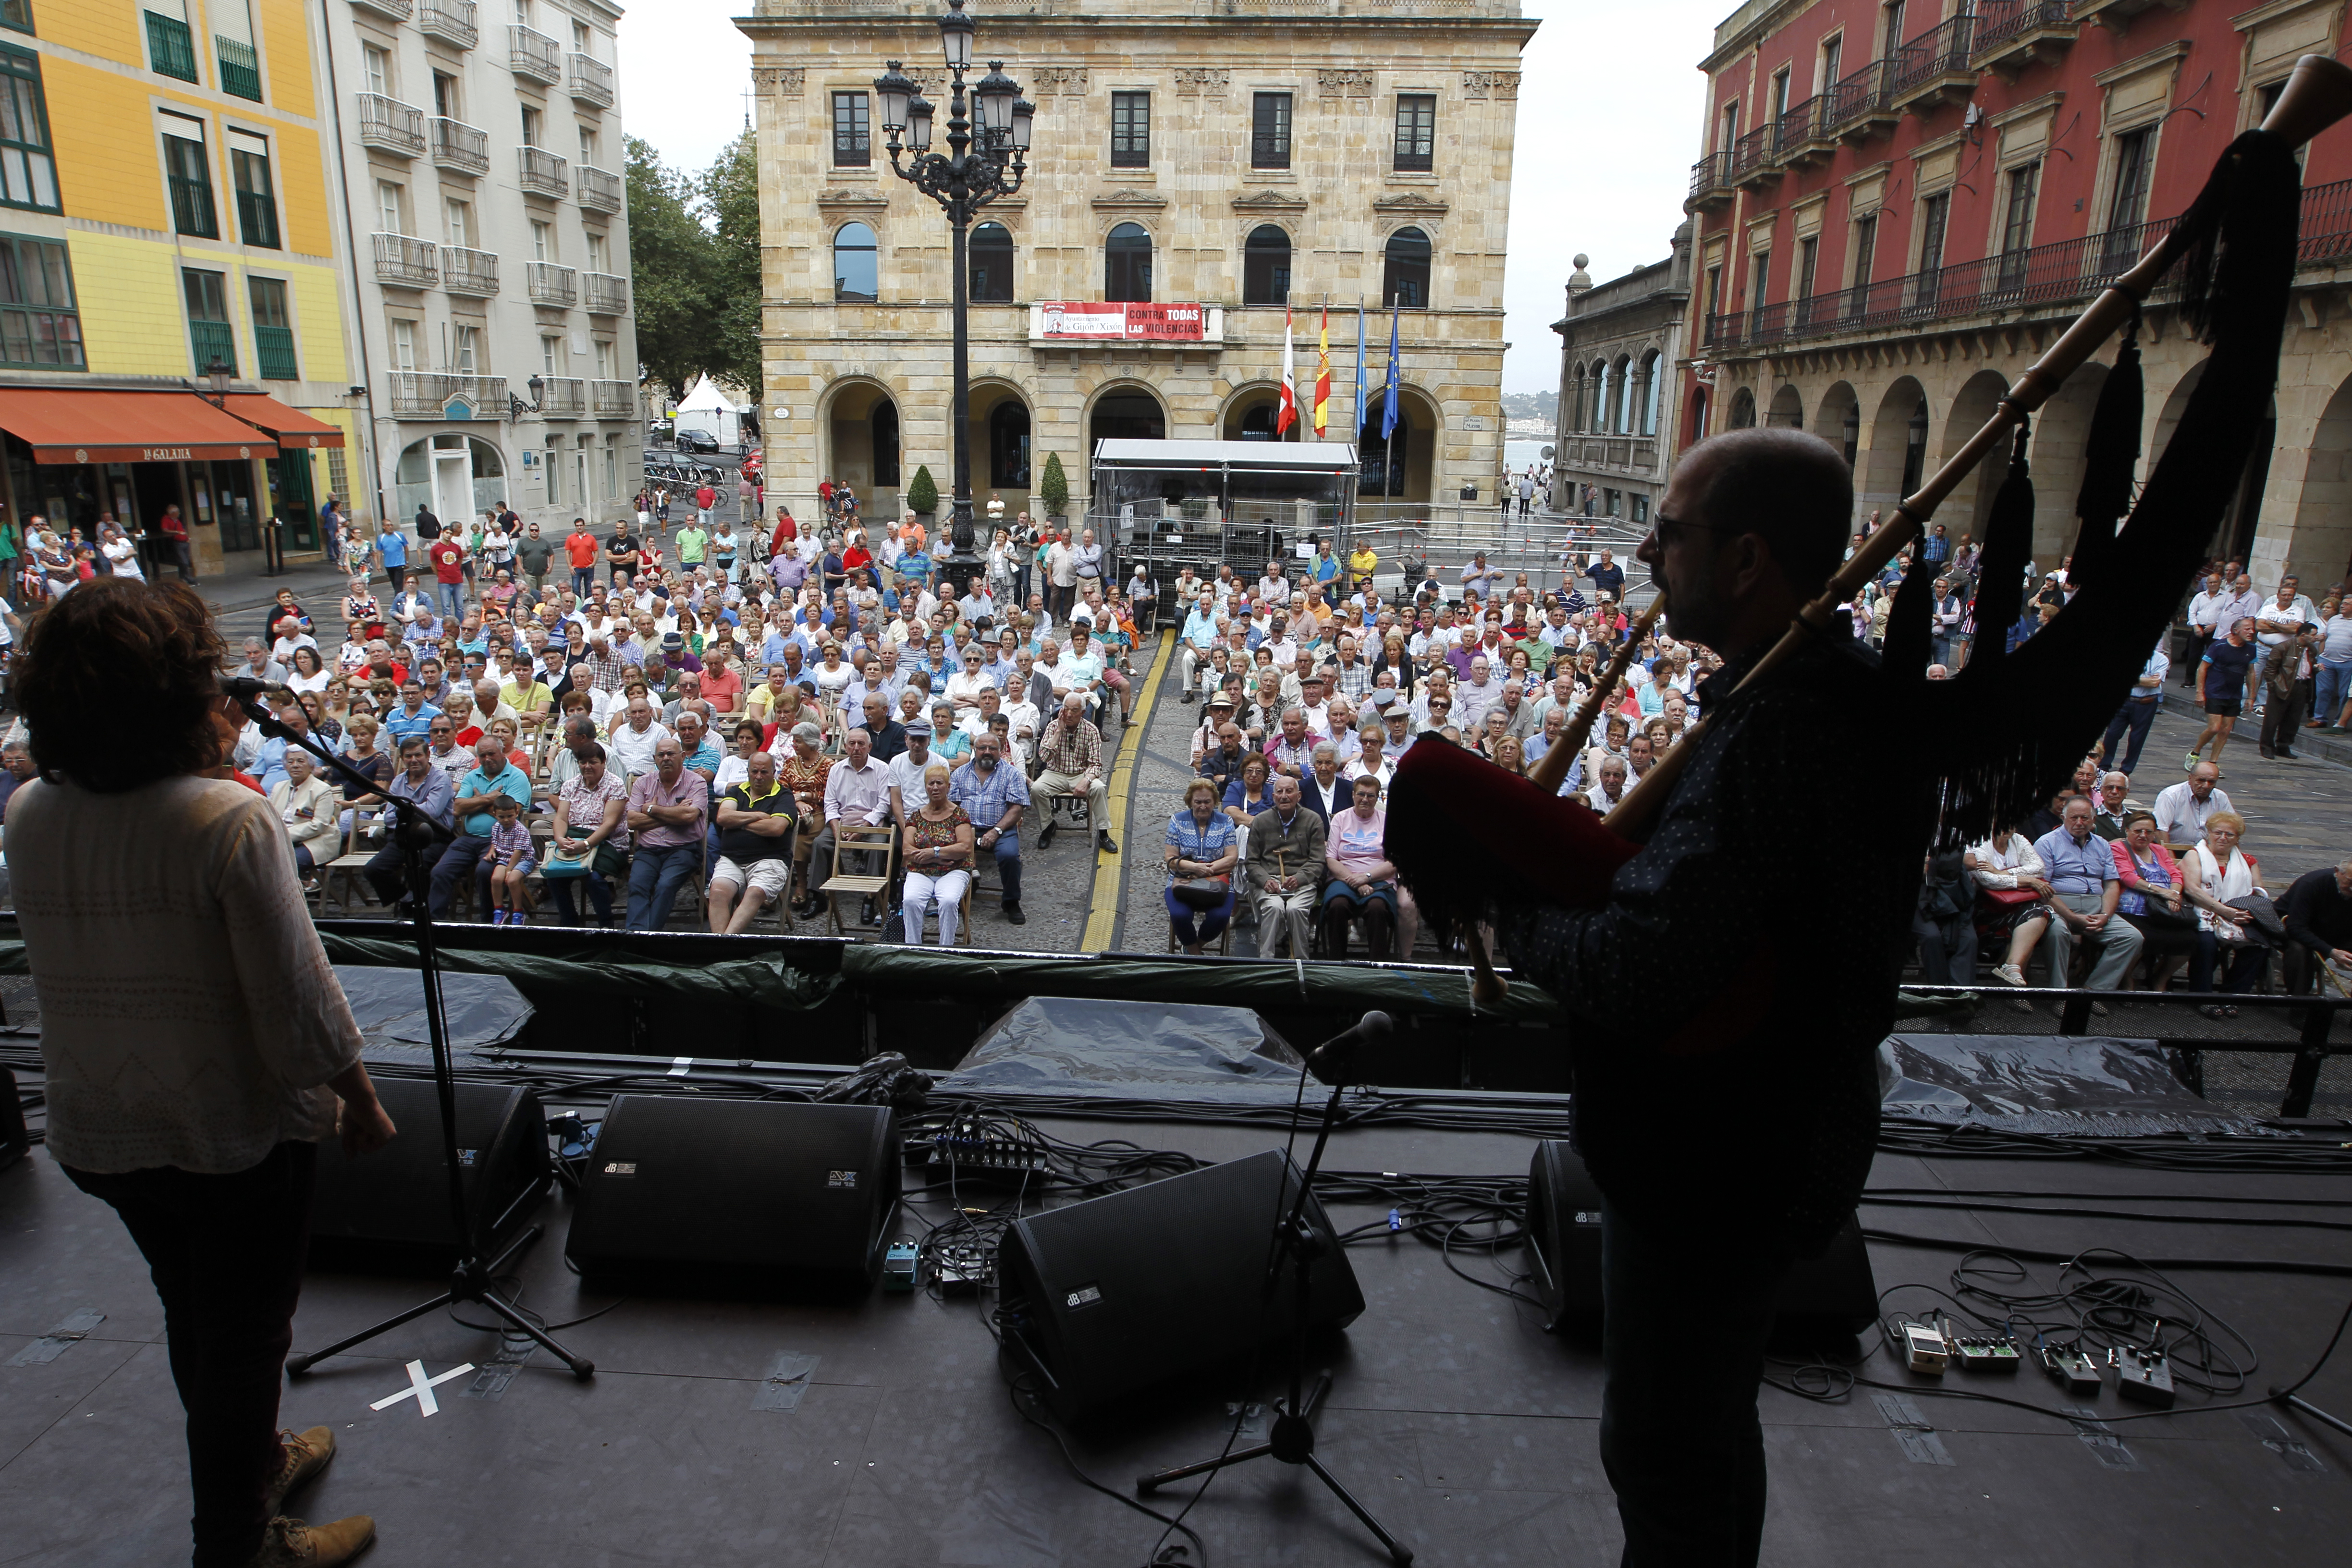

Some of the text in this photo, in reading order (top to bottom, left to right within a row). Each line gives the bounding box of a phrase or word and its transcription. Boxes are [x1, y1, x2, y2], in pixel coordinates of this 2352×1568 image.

[1129, 309, 1199, 320] CONTRA TODAS
[1073, 323, 1094, 332] Gijón
[1129, 324, 1199, 333] LAS VIOLENCIAS
[153, 448, 192, 460] GALANA
[605, 1163, 617, 1173] dB
[1575, 1212, 1587, 1222] dB
[1067, 1293, 1080, 1306] dB
